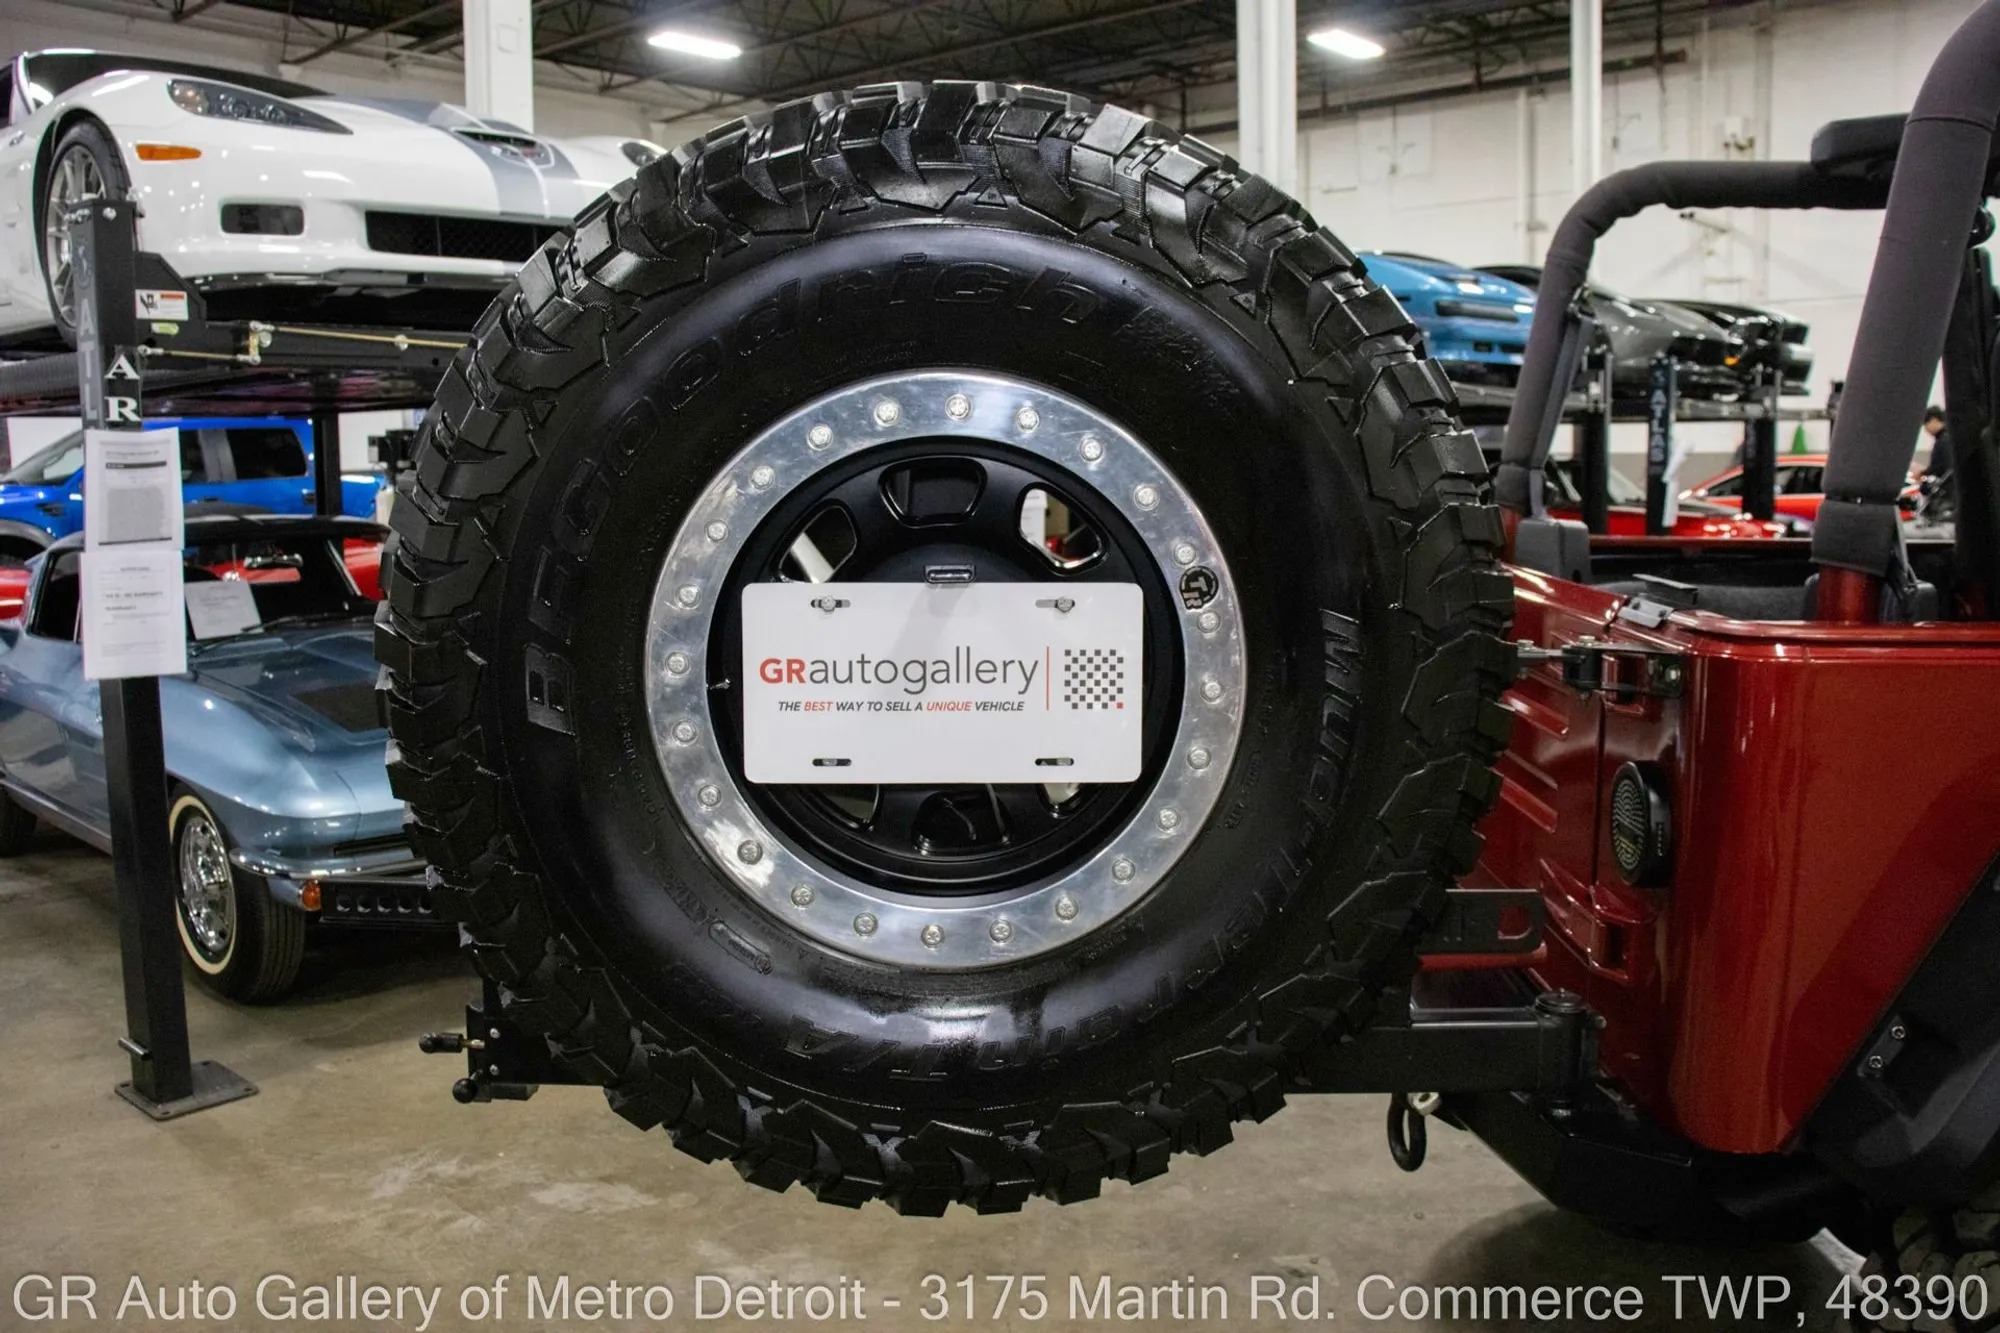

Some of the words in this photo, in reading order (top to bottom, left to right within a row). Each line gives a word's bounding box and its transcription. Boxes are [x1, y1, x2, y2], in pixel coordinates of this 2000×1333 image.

[778, 701, 802, 712] THE
[804, 701, 833, 712] BEST
[836, 701, 864, 712] WAY
[867, 701, 883, 712] TO
[885, 701, 912, 712] SELL
[914, 701, 923, 712] A
[926, 701, 971, 713] UNIQUE
[975, 701, 1025, 712] VEHICLE
